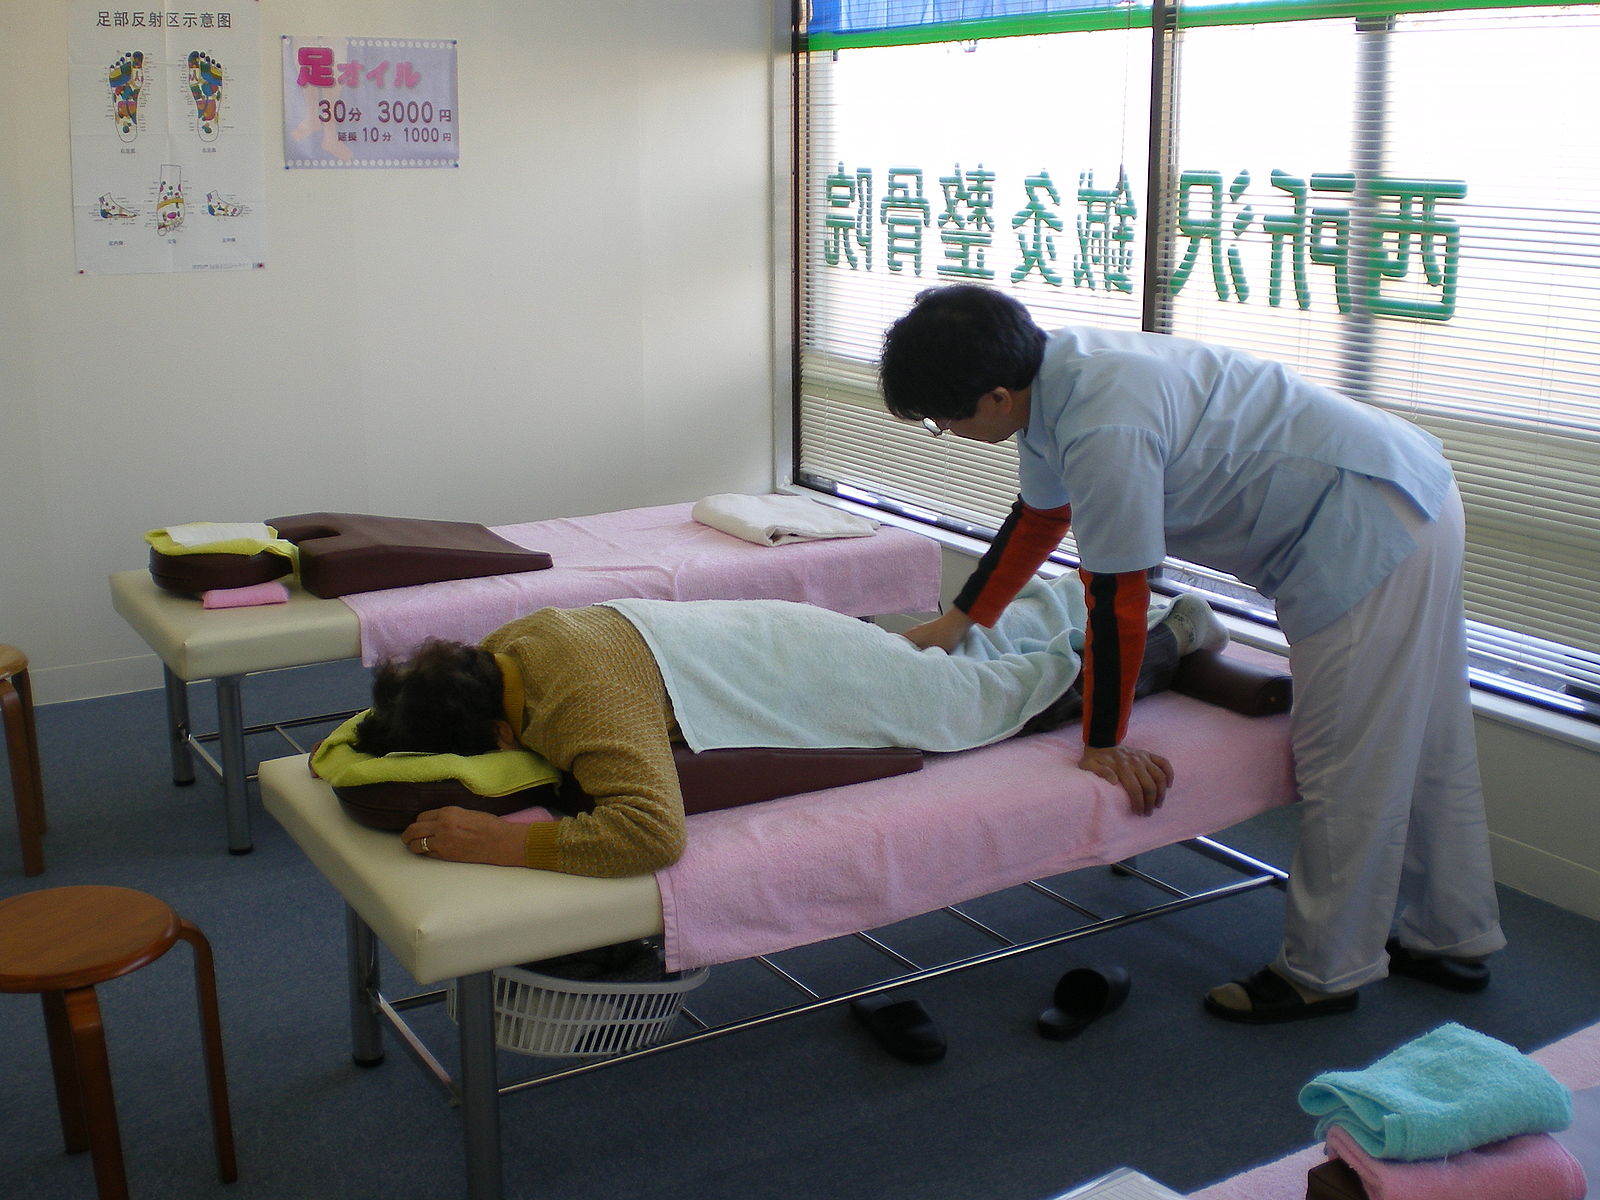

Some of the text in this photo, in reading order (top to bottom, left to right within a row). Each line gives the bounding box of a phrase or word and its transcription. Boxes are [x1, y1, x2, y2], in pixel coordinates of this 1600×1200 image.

[96, 11, 231, 28] 足部反射区示意图
[297, 46, 421, 88] 足オイル
[318, 99, 452, 123] 30分 3000円
[403, 127, 452, 142] 1000円
